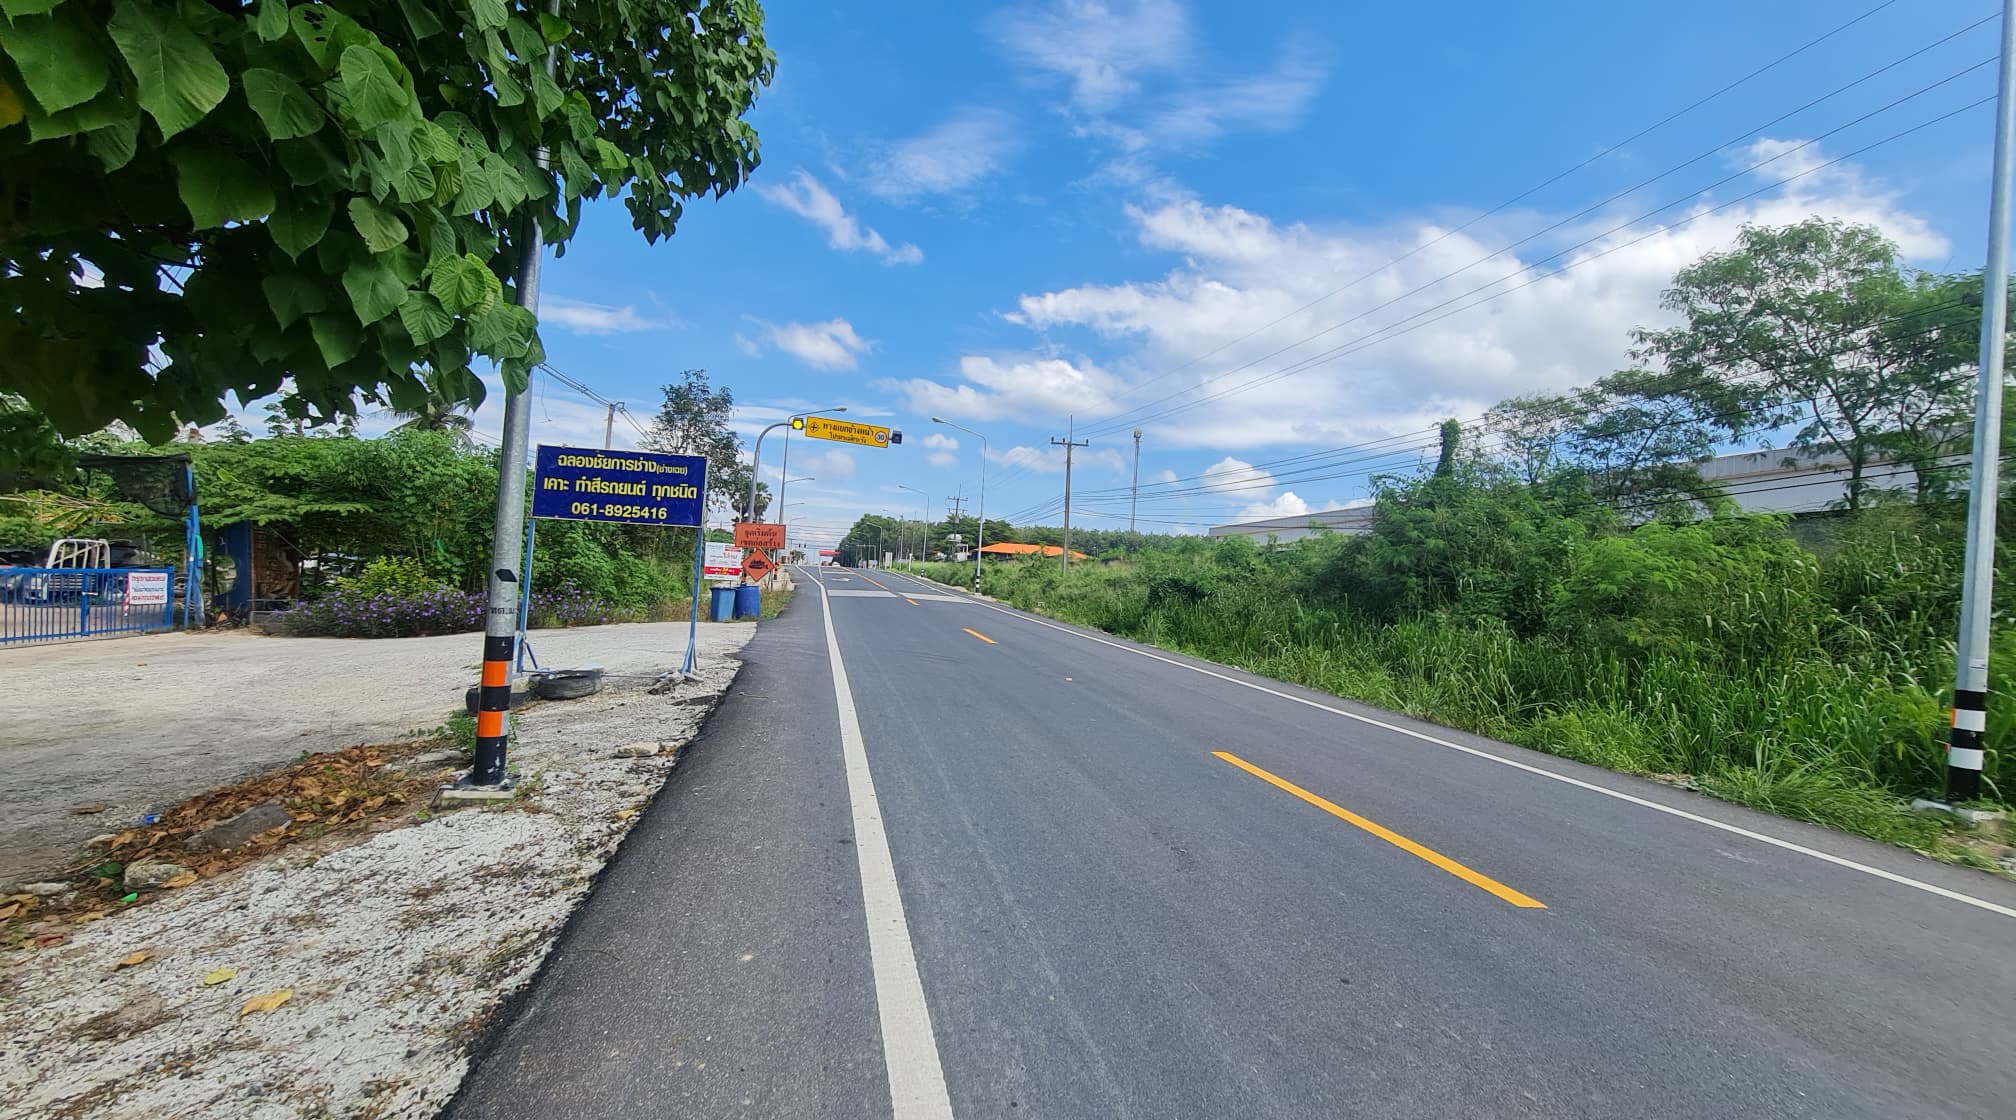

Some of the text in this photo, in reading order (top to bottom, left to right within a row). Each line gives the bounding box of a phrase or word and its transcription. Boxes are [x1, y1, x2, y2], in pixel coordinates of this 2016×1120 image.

[543, 476, 697, 501] เคาะ ทำสีรถยนต์ ทุกชนิด
[571, 502, 667, 519] 061-8925416
